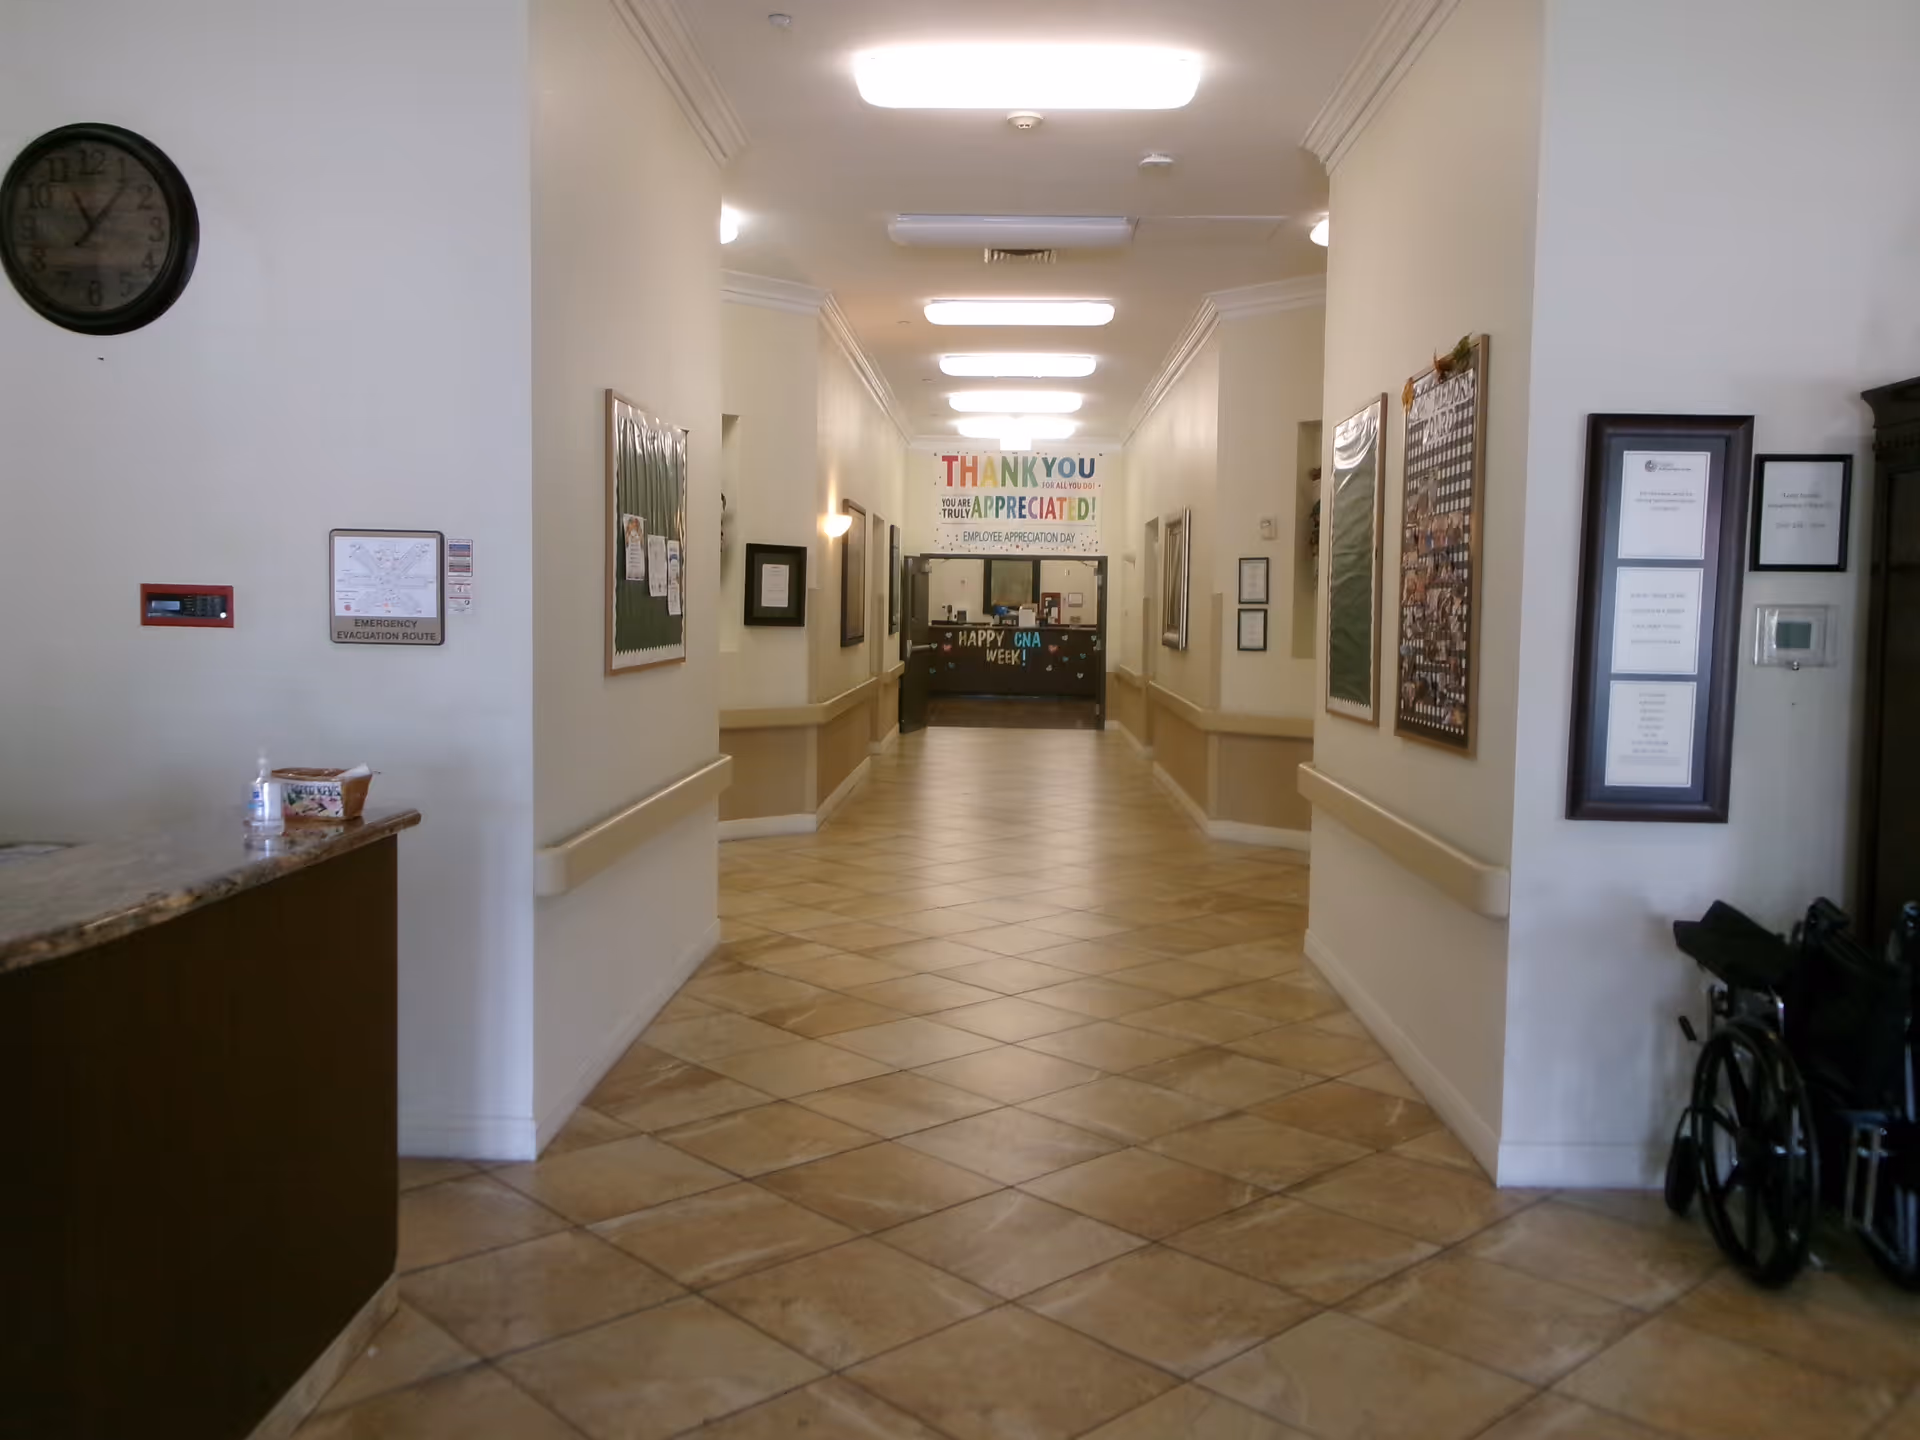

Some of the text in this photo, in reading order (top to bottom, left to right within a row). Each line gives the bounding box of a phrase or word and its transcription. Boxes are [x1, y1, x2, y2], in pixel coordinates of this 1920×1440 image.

[48, 157, 69, 183] 11
[79, 151, 105, 175] 12
[27, 183, 52, 209] 10
[138, 184, 153, 210] 2
[149, 217, 164, 242] 3
[142, 252, 157, 274] 4
[942, 455, 1095, 487] THANK YOU
[942, 498, 971, 508] YOU ARE
[942, 495, 1096, 520] TRULY APPRECIATED!
[963, 531, 1075, 543] EMPLOYEE APPRECIATION DAY
[354, 619, 418, 628] EMERGENCY
[337, 631, 436, 641] EVACUATION ROUTE
[958, 629, 1041, 648] HAPPY CNA
[986, 648, 1026, 666] WEEK!
